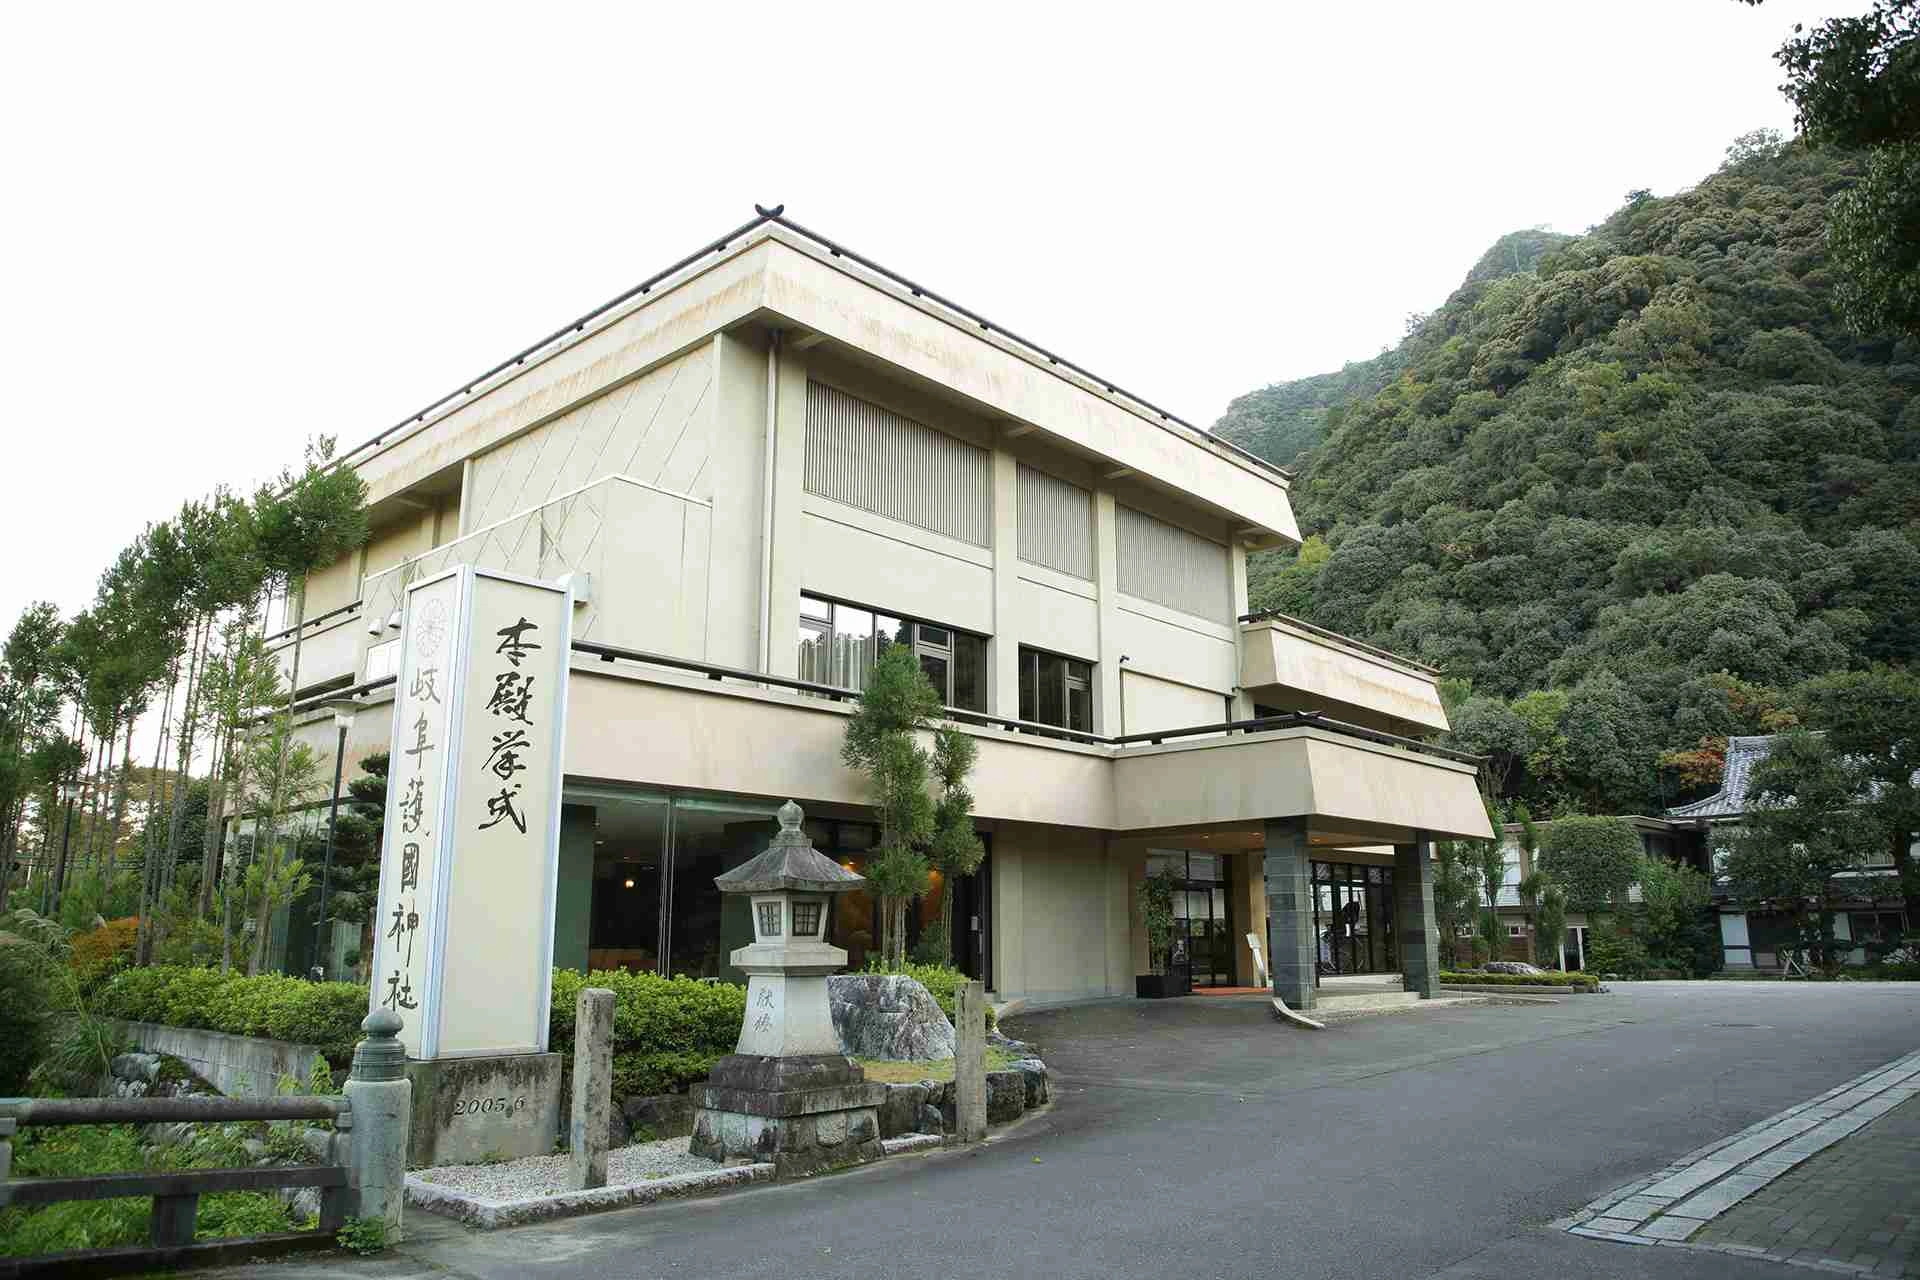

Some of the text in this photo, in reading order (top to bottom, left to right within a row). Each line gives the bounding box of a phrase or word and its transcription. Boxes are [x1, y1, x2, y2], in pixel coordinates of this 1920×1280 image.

[382, 667, 441, 1013] 岐阜護國神社
[478, 616, 542, 834] 本殿挙式
